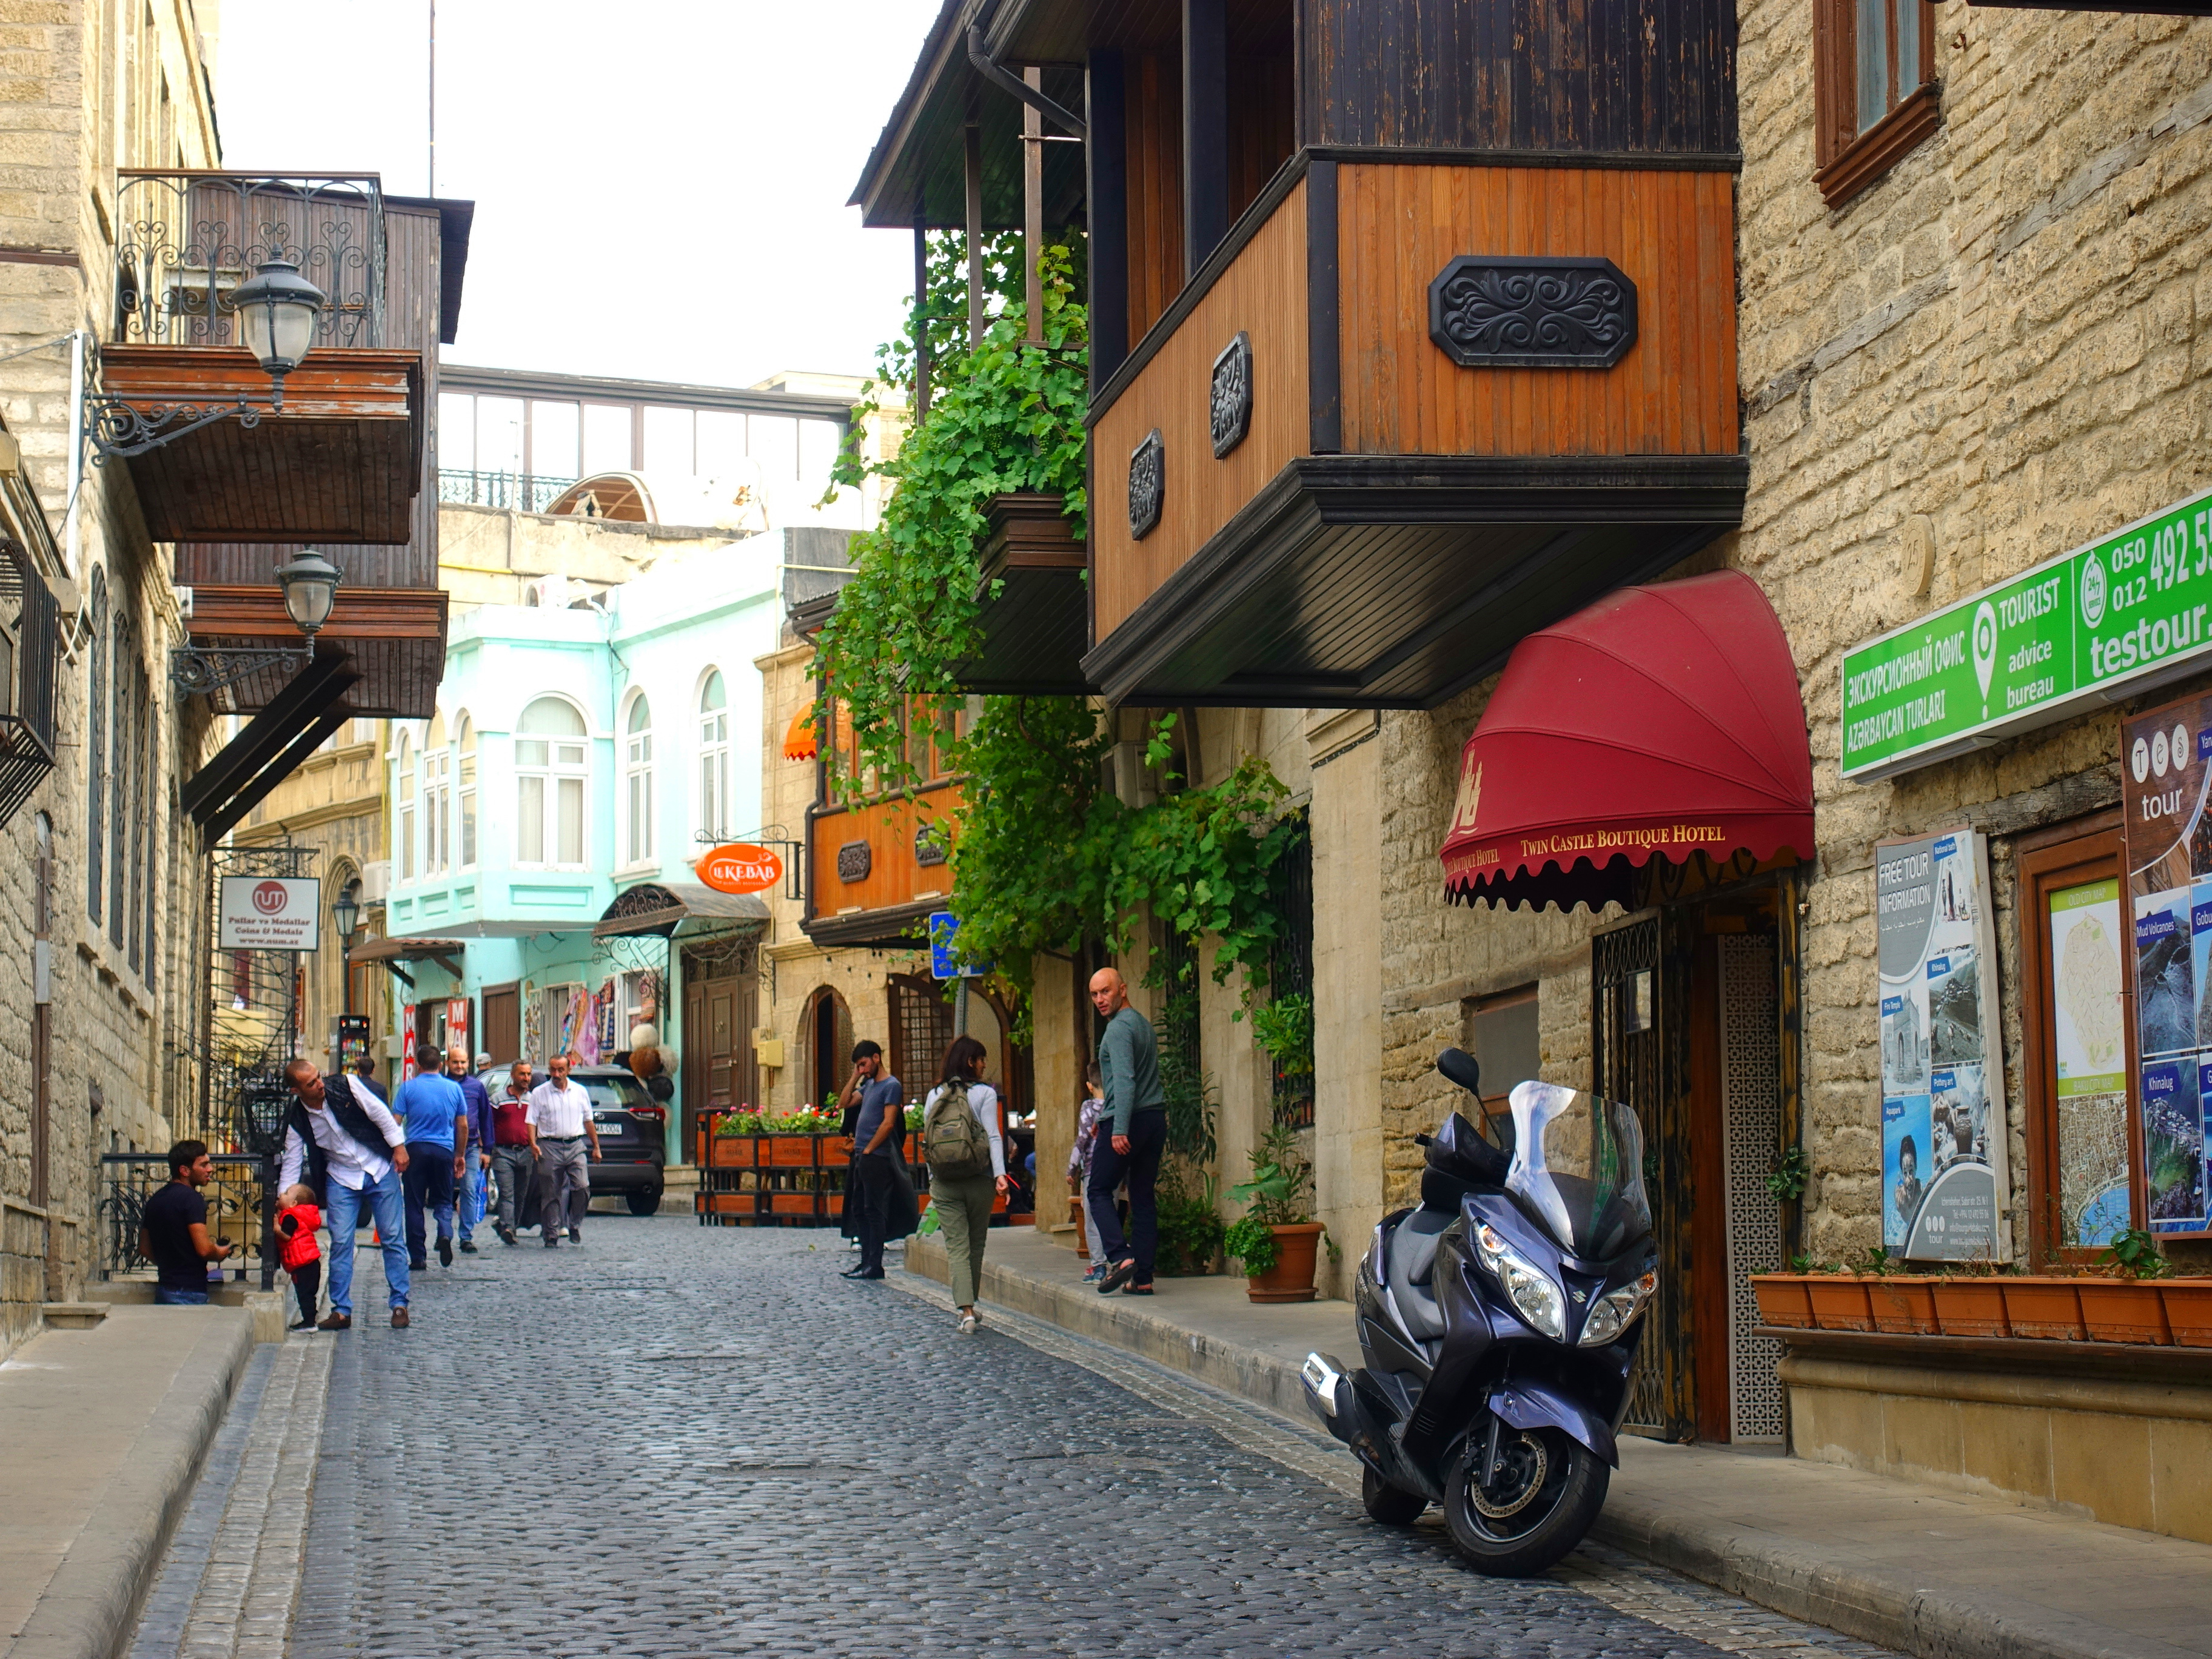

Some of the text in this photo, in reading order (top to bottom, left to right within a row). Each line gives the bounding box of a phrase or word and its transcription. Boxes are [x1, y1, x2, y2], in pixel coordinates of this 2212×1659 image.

[2112, 537, 2146, 573] 050
[2150, 520, 2189, 592] 492
[2088, 574, 2100, 595] 24/7
[2113, 576, 2147, 612] 012
[1999, 577, 2060, 631] TOURIST
[1848, 630, 1965, 708] ЭКСКУРСИОННЫЙ ОФИС
[2009, 640, 2053, 674] advice
[2007, 675, 2054, 709] bureau
[1848, 689, 1945, 754] AZƏRBAYCAN TURLARI
[2201, 735, 2212, 749] Yan
[2142, 789, 2183, 821] tour
[1550, 833, 1595, 853] CASTLE
[1597, 828, 1669, 849] BOUTIQUE
[1672, 825, 1725, 842] HOTEL
[1476, 849, 1500, 866] HOTEL
[1880, 851, 1929, 887] FREE TOUR
[725, 865, 775, 882] KEBAB
[1879, 883, 1931, 914] INFORMATION
[2068, 893, 2080, 907] OLD
[2094, 887, 2106, 900] MAP
[272, 917, 310, 926] Medallar
[2137, 921, 2174, 937] Mud Volcanoes
[1934, 1078, 1947, 1088] Pottery
[2148, 1075, 2173, 1091] Khinalug
[1929, 1235, 1943, 1244] tour
